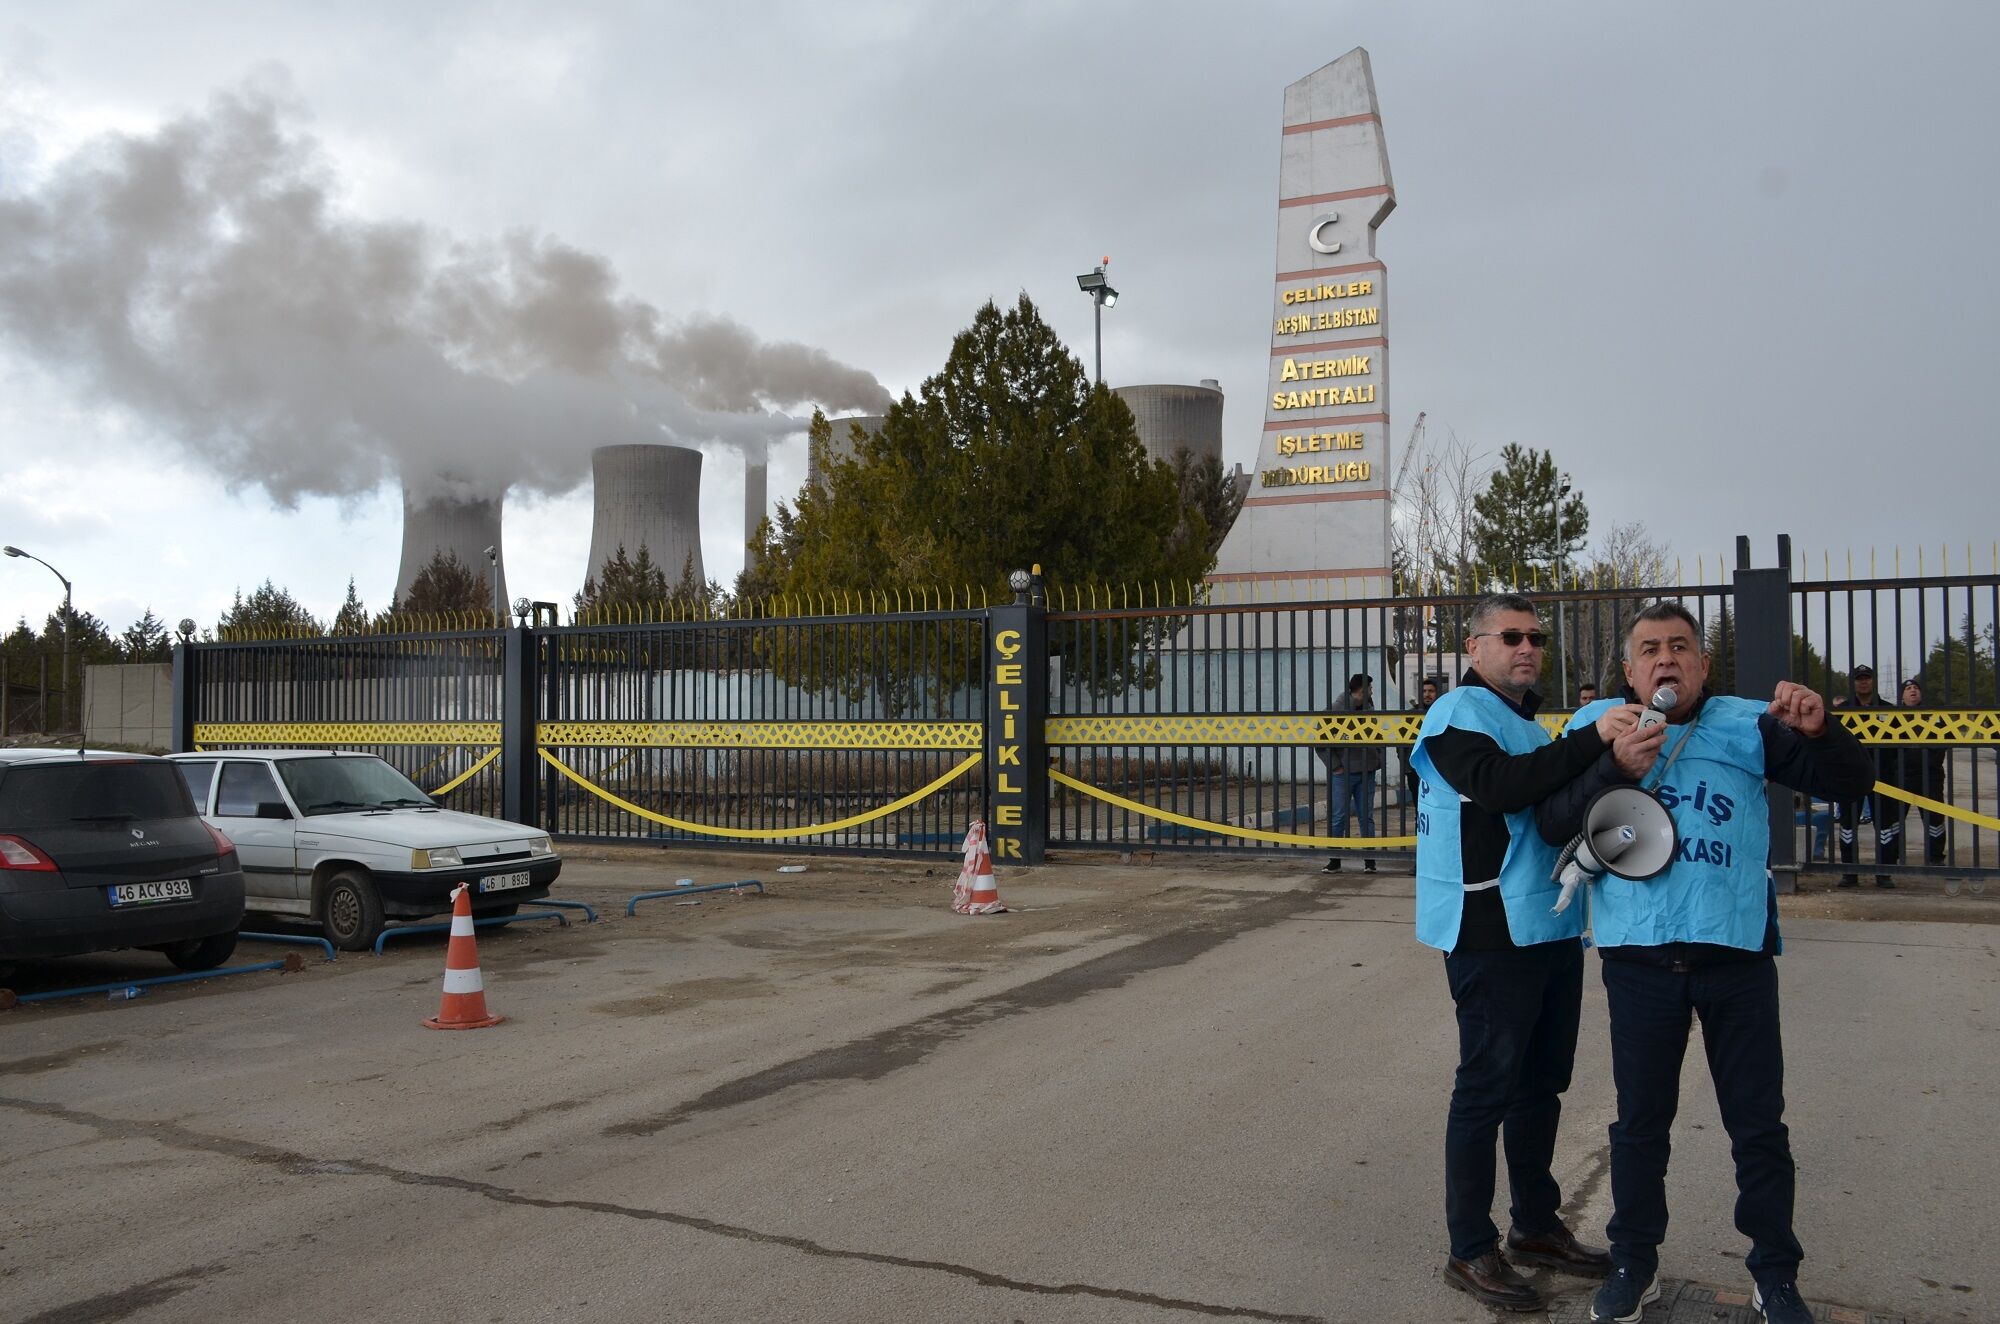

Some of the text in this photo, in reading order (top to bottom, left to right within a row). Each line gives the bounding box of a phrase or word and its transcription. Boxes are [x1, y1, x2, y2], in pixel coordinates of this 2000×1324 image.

[995, 630, 1023, 859] ÇELİKLER
[1657, 780, 1735, 827] S-İŞ
[1675, 837, 1732, 868] KASI
[118, 885, 135, 900] 46
[139, 882, 164, 899] ACK
[165, 881, 190, 896] 933
[486, 873, 529, 890] 46 D 8929
